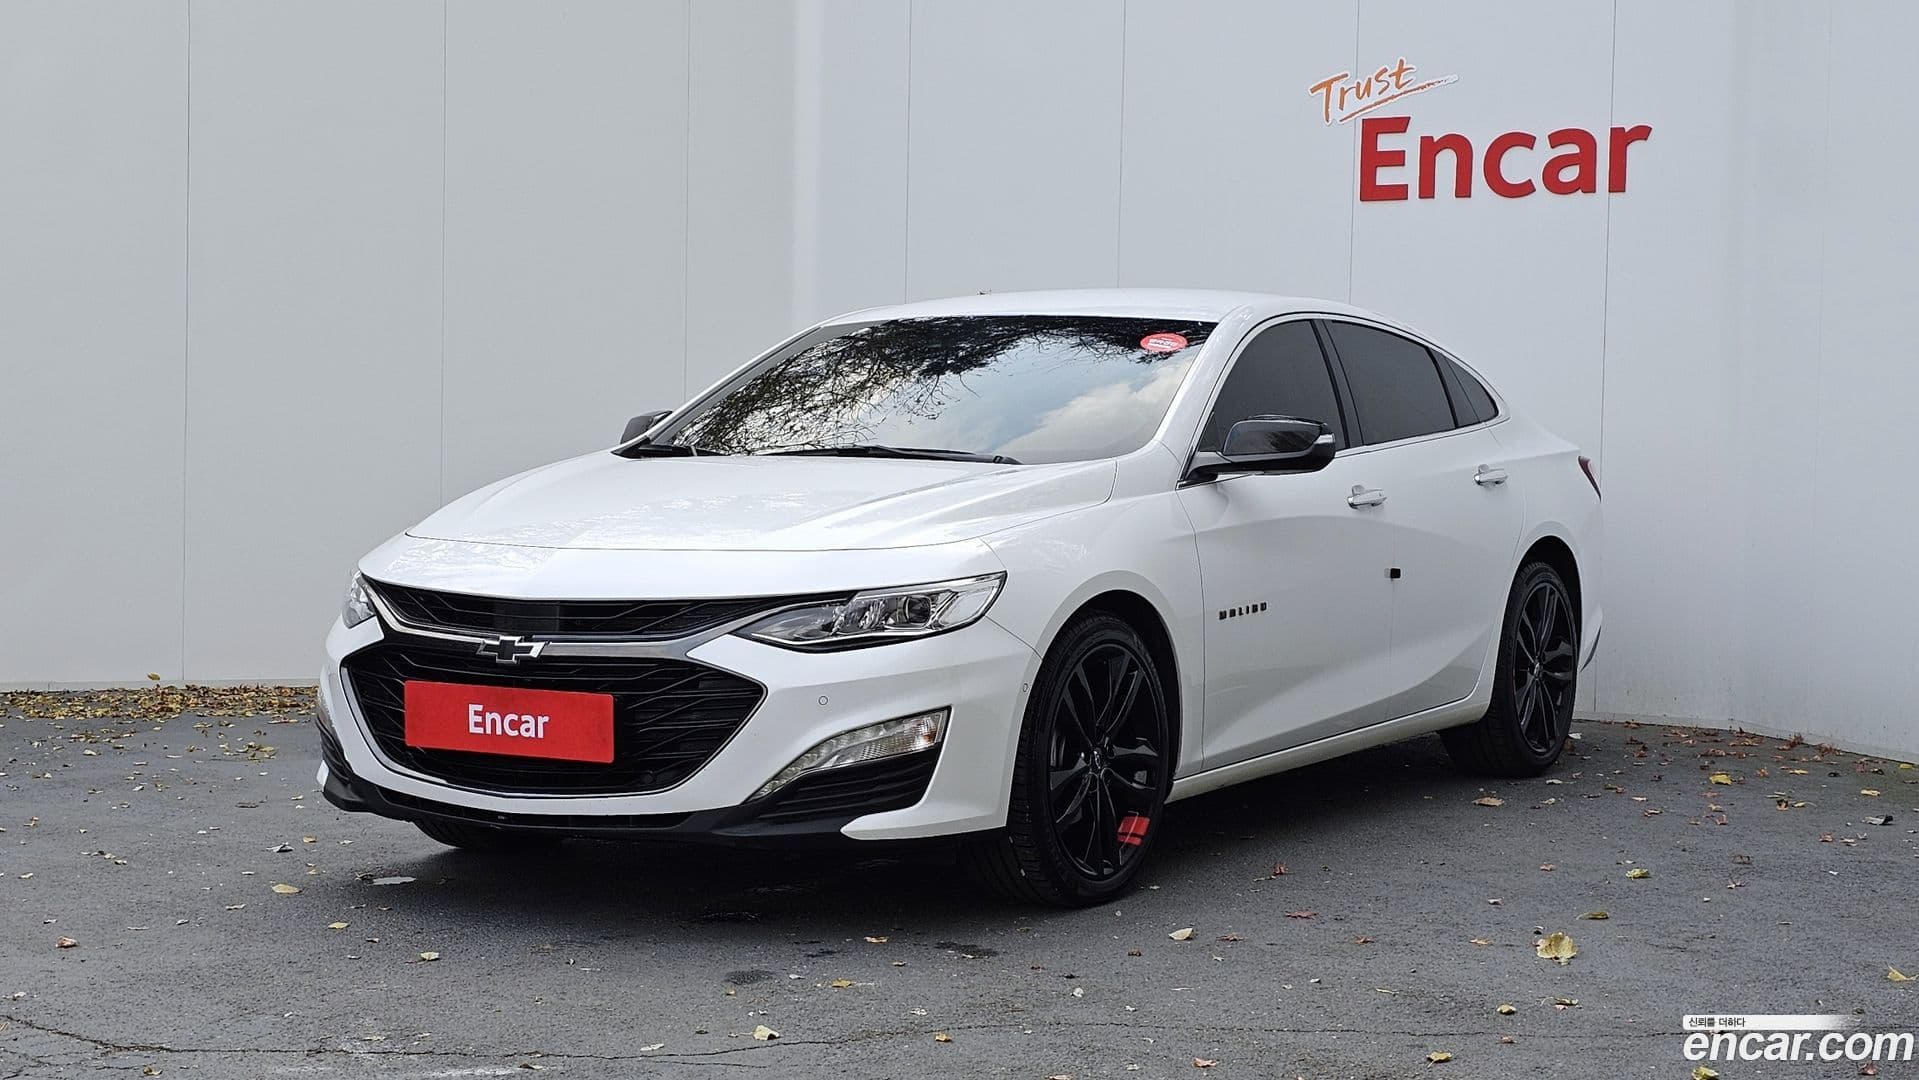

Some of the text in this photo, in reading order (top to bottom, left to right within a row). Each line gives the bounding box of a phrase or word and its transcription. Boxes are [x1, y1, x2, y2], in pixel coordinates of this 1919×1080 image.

[1309, 59, 1415, 123] Trust
[1360, 116, 1653, 202] Encar
[468, 703, 550, 739] Encar
